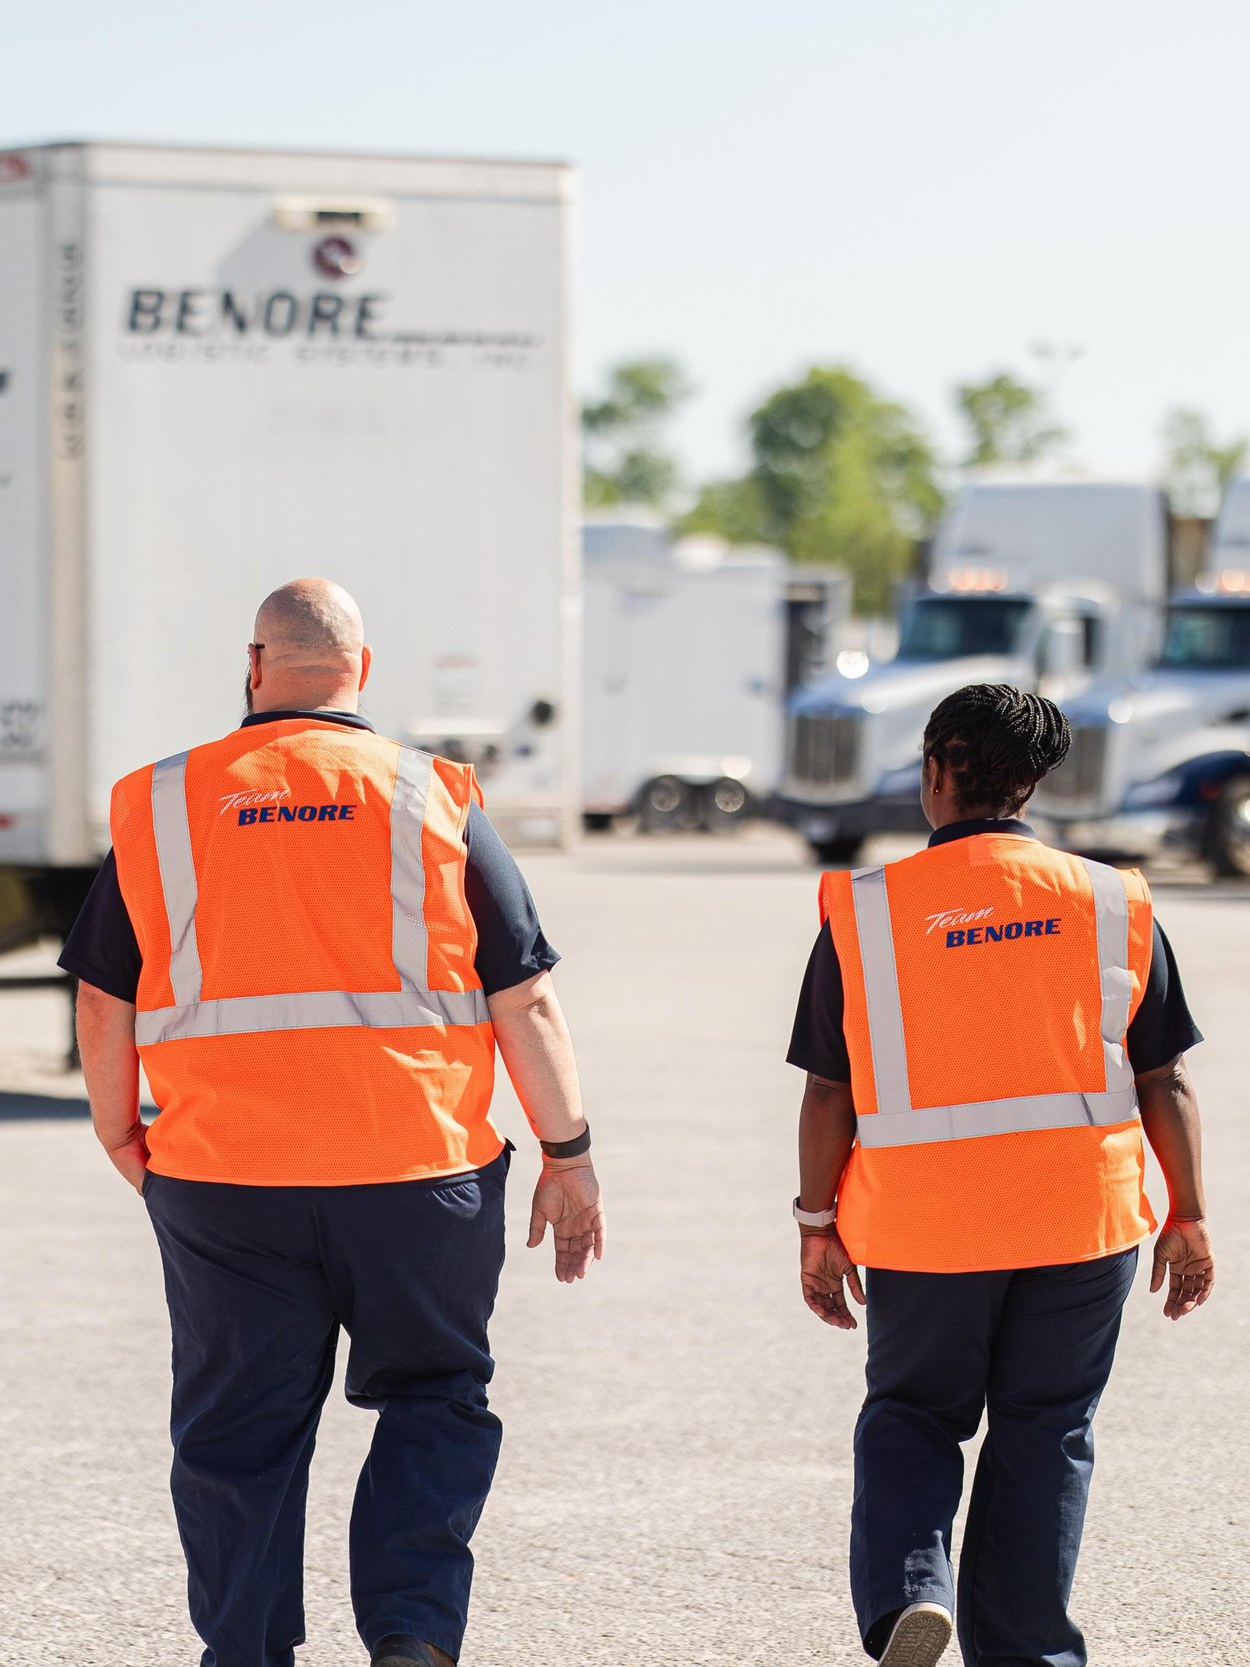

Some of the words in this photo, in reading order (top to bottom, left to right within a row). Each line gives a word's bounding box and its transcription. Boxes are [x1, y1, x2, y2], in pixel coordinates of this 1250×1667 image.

[127, 287, 392, 343] BENORE
[220, 788, 291, 816] Team
[238, 804, 357, 826] BENORE
[925, 906, 994, 935] Team
[946, 918, 1062, 948] BENORE
